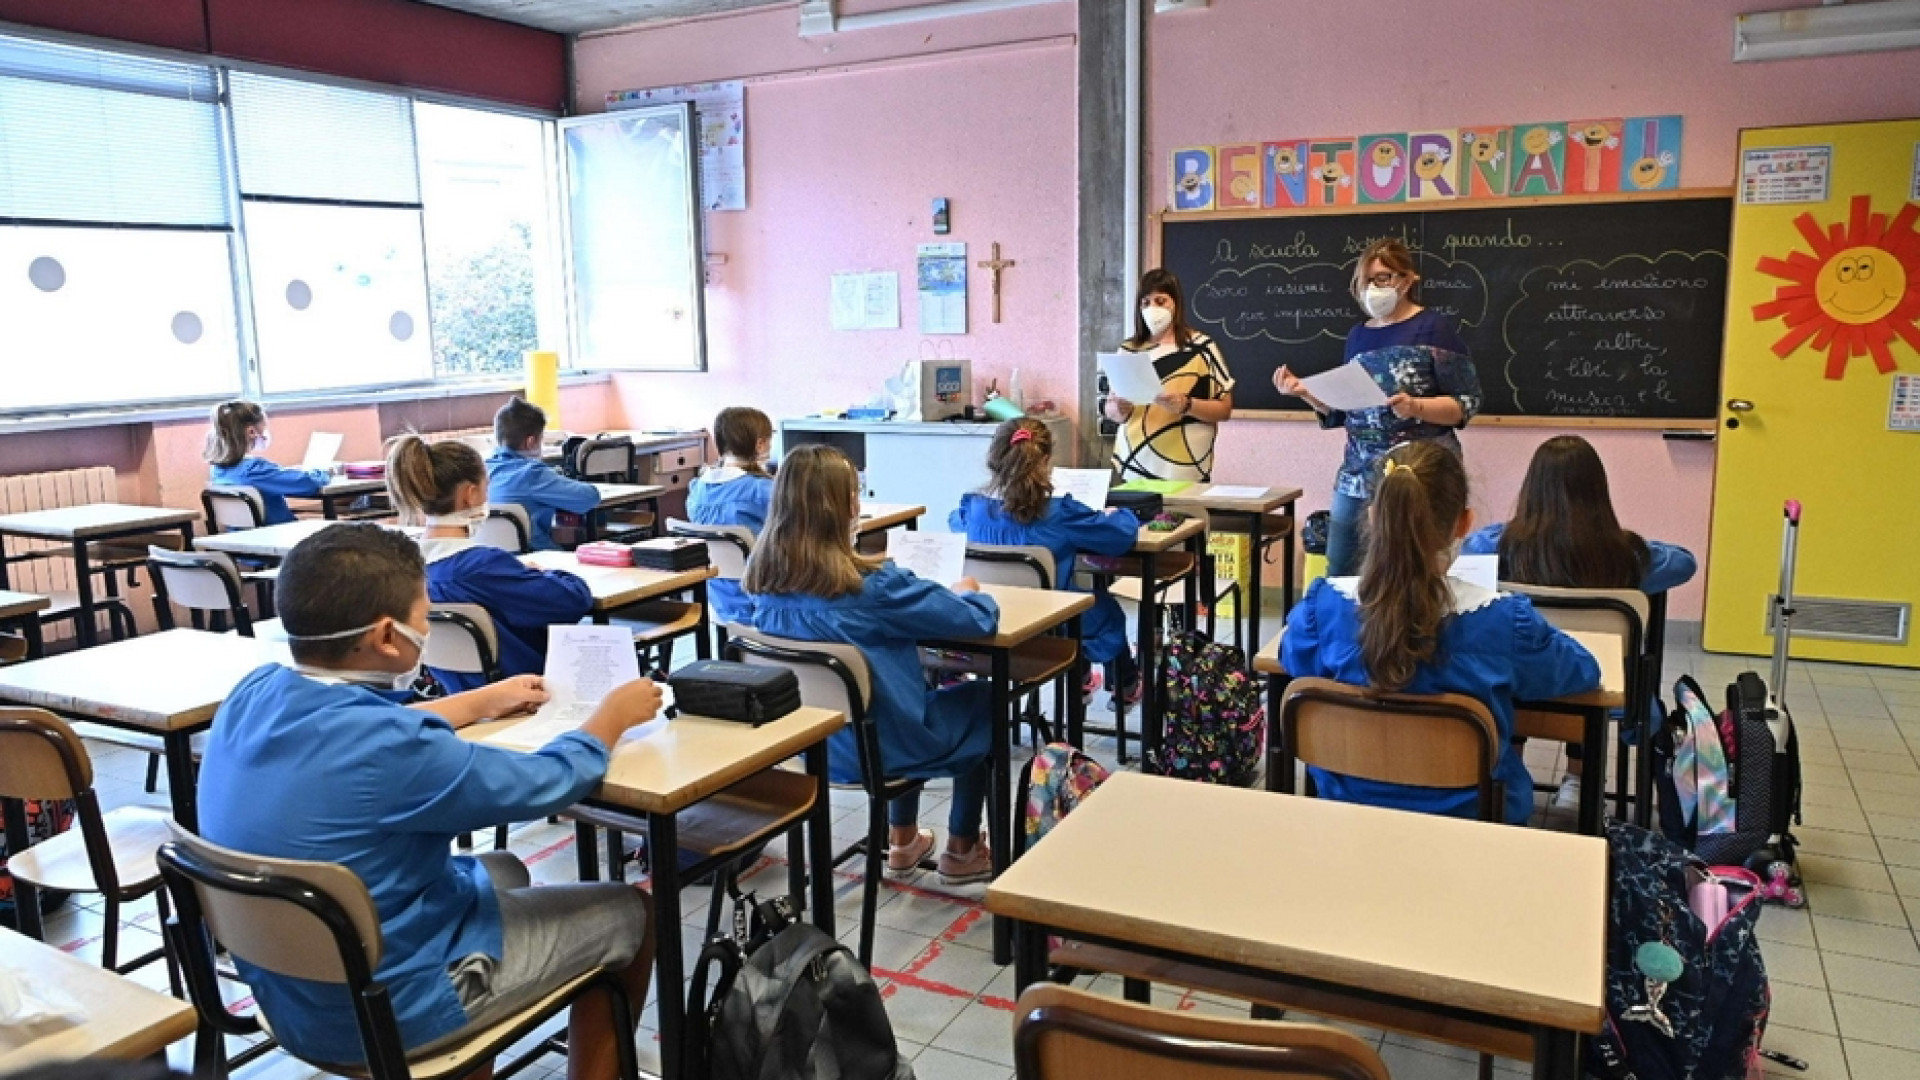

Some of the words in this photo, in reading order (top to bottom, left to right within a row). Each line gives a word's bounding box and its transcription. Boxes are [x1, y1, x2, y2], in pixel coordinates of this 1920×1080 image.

[1248, 230, 1320, 259] scuola
[1342, 223, 1422, 252] sordi
[1546, 271, 1583, 291] mi
[1593, 271, 1709, 290] emoziono
[1273, 304, 1358, 330] imparare
[1545, 303, 1666, 323] attraverso
[1640, 353, 1669, 376] la
